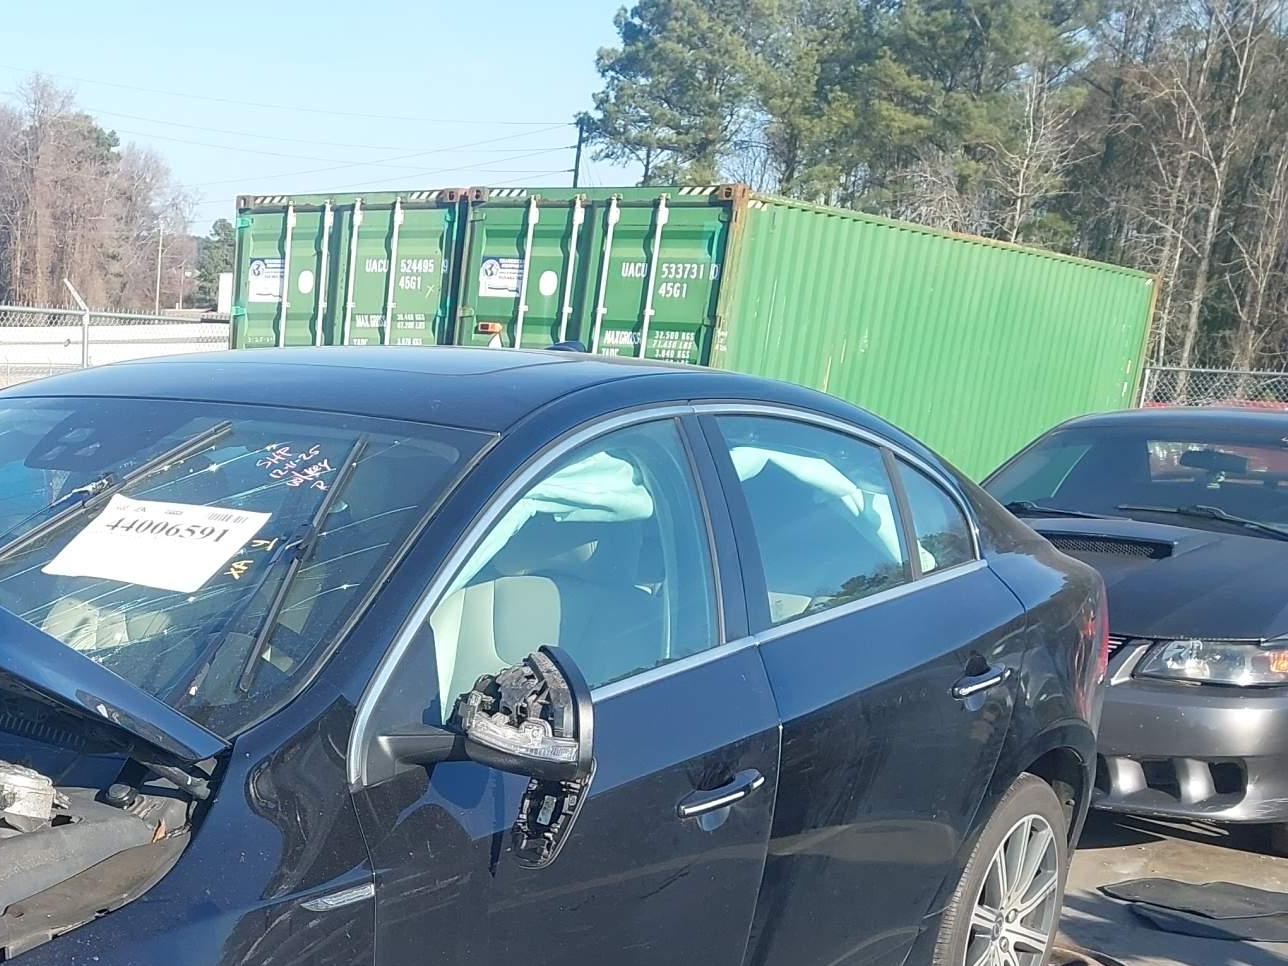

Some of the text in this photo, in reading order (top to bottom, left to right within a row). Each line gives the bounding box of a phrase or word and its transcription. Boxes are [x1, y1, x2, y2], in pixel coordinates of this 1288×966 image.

[365, 258, 450, 274] UACU 524495 9
[621, 262, 649, 278] UACU
[661, 263, 705, 279] 533731
[398, 275, 422, 290] 45G1
[658, 282, 688, 298] 45G1
[106, 517, 230, 542] 44006591
